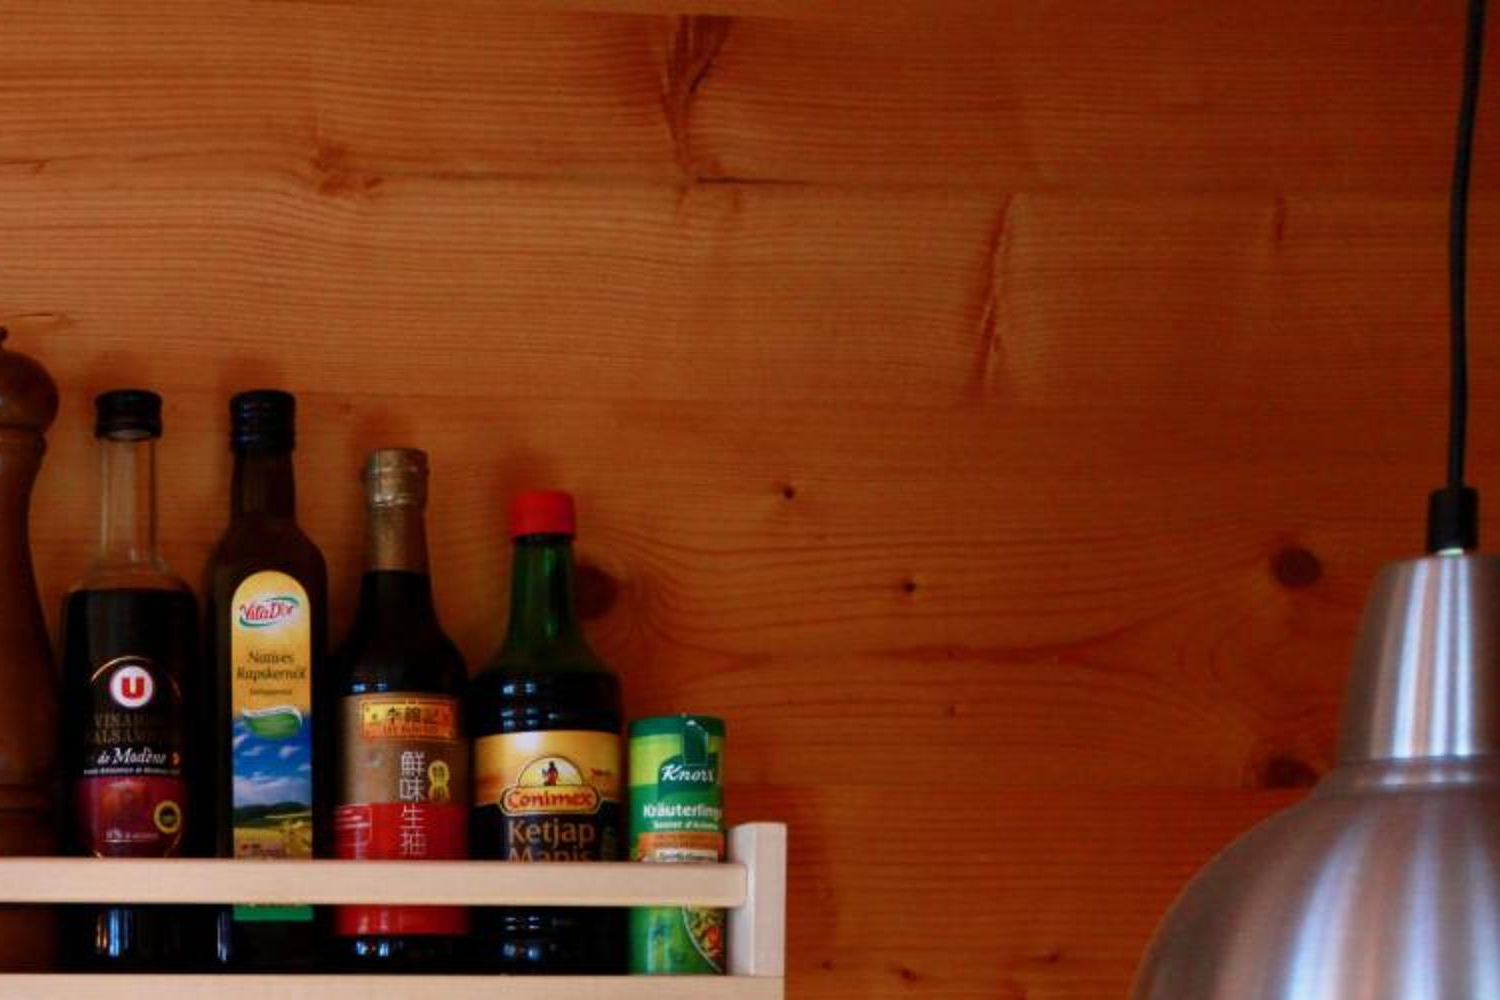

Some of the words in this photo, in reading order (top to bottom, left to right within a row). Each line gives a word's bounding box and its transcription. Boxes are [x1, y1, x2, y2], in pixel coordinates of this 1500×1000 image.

[248, 651, 295, 664] Natives
[121, 676, 146, 700] U
[661, 763, 715, 783] Knorr
[508, 791, 594, 808] Conimex
[508, 818, 595, 849] Ketjap
